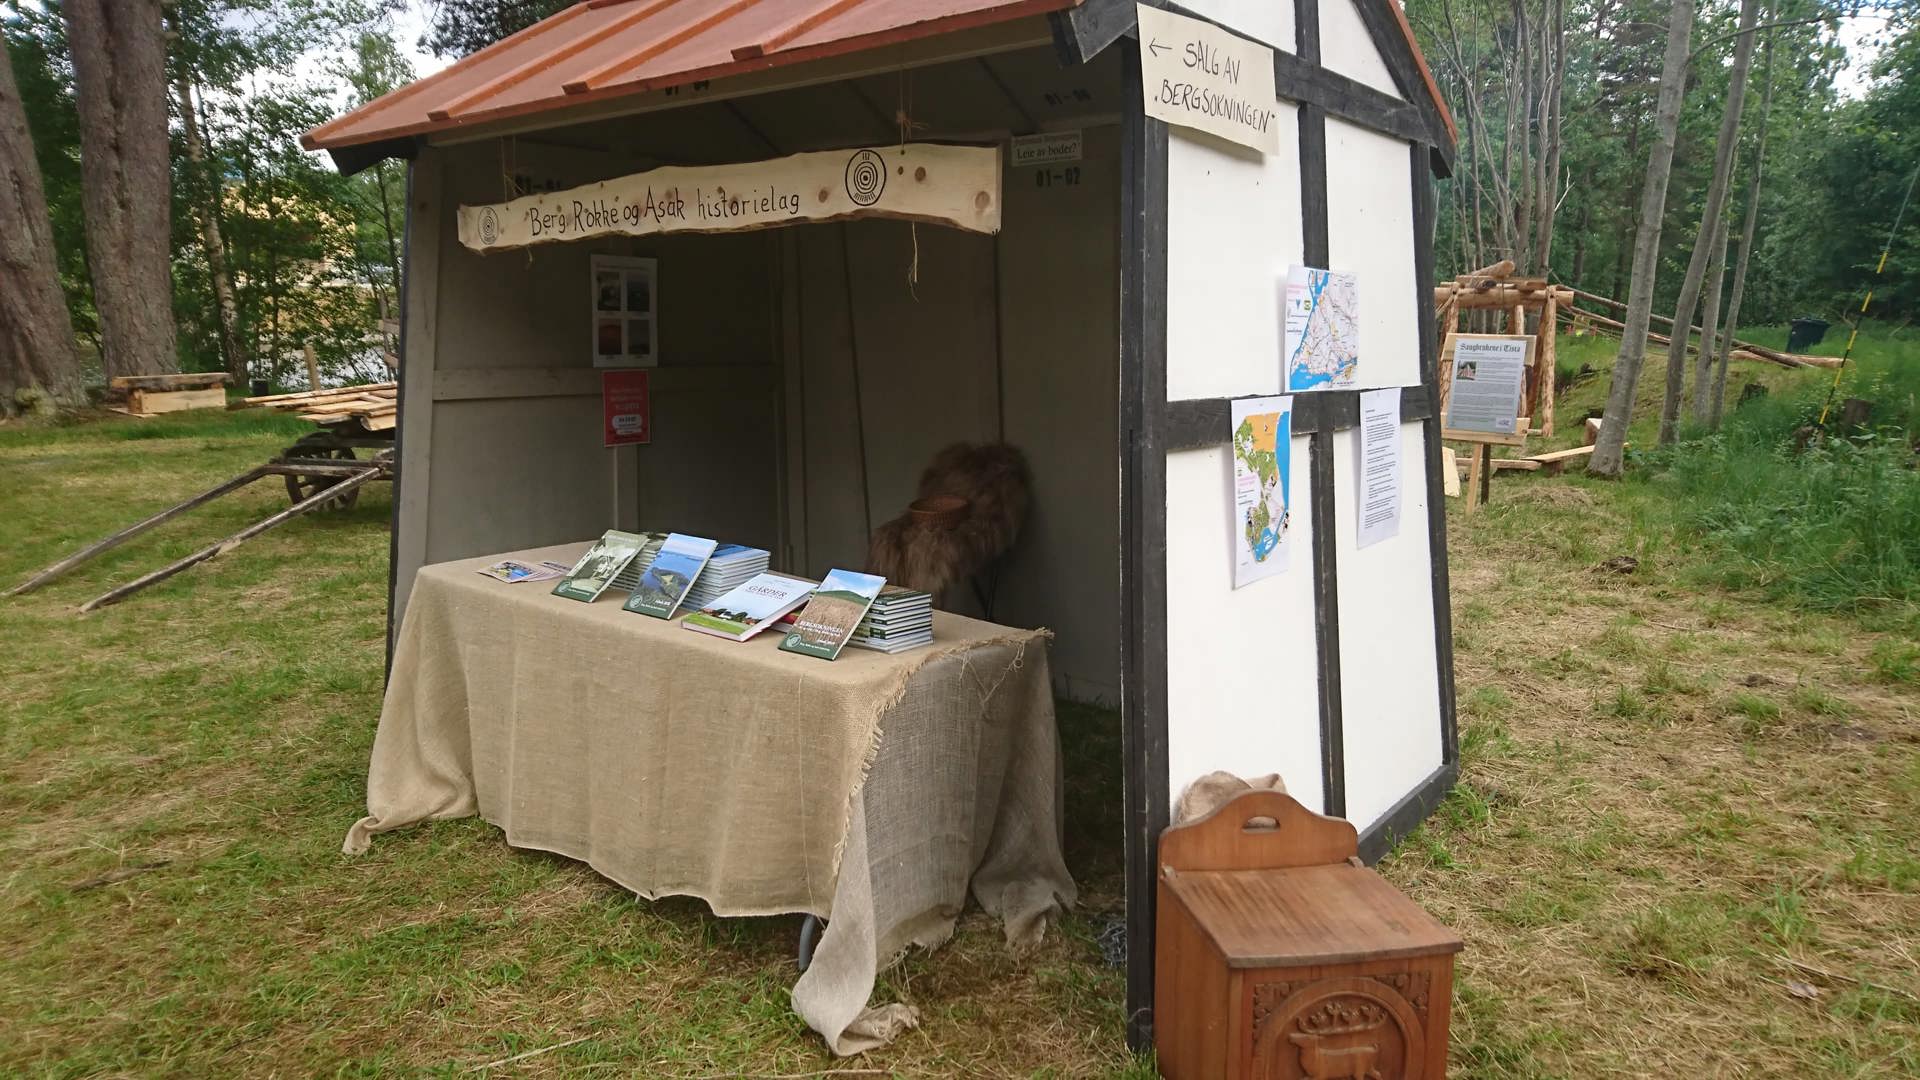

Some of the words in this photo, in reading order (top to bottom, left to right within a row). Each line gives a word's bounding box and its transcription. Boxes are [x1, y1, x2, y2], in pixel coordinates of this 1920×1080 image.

[1183, 40, 1219, 76] SALG
[1223, 56, 1241, 85] AV
[1036, 166, 1081, 187] 01-02
[623, 204, 639, 227] og
[644, 184, 686, 224] Asak
[697, 184, 800, 219] historielag
